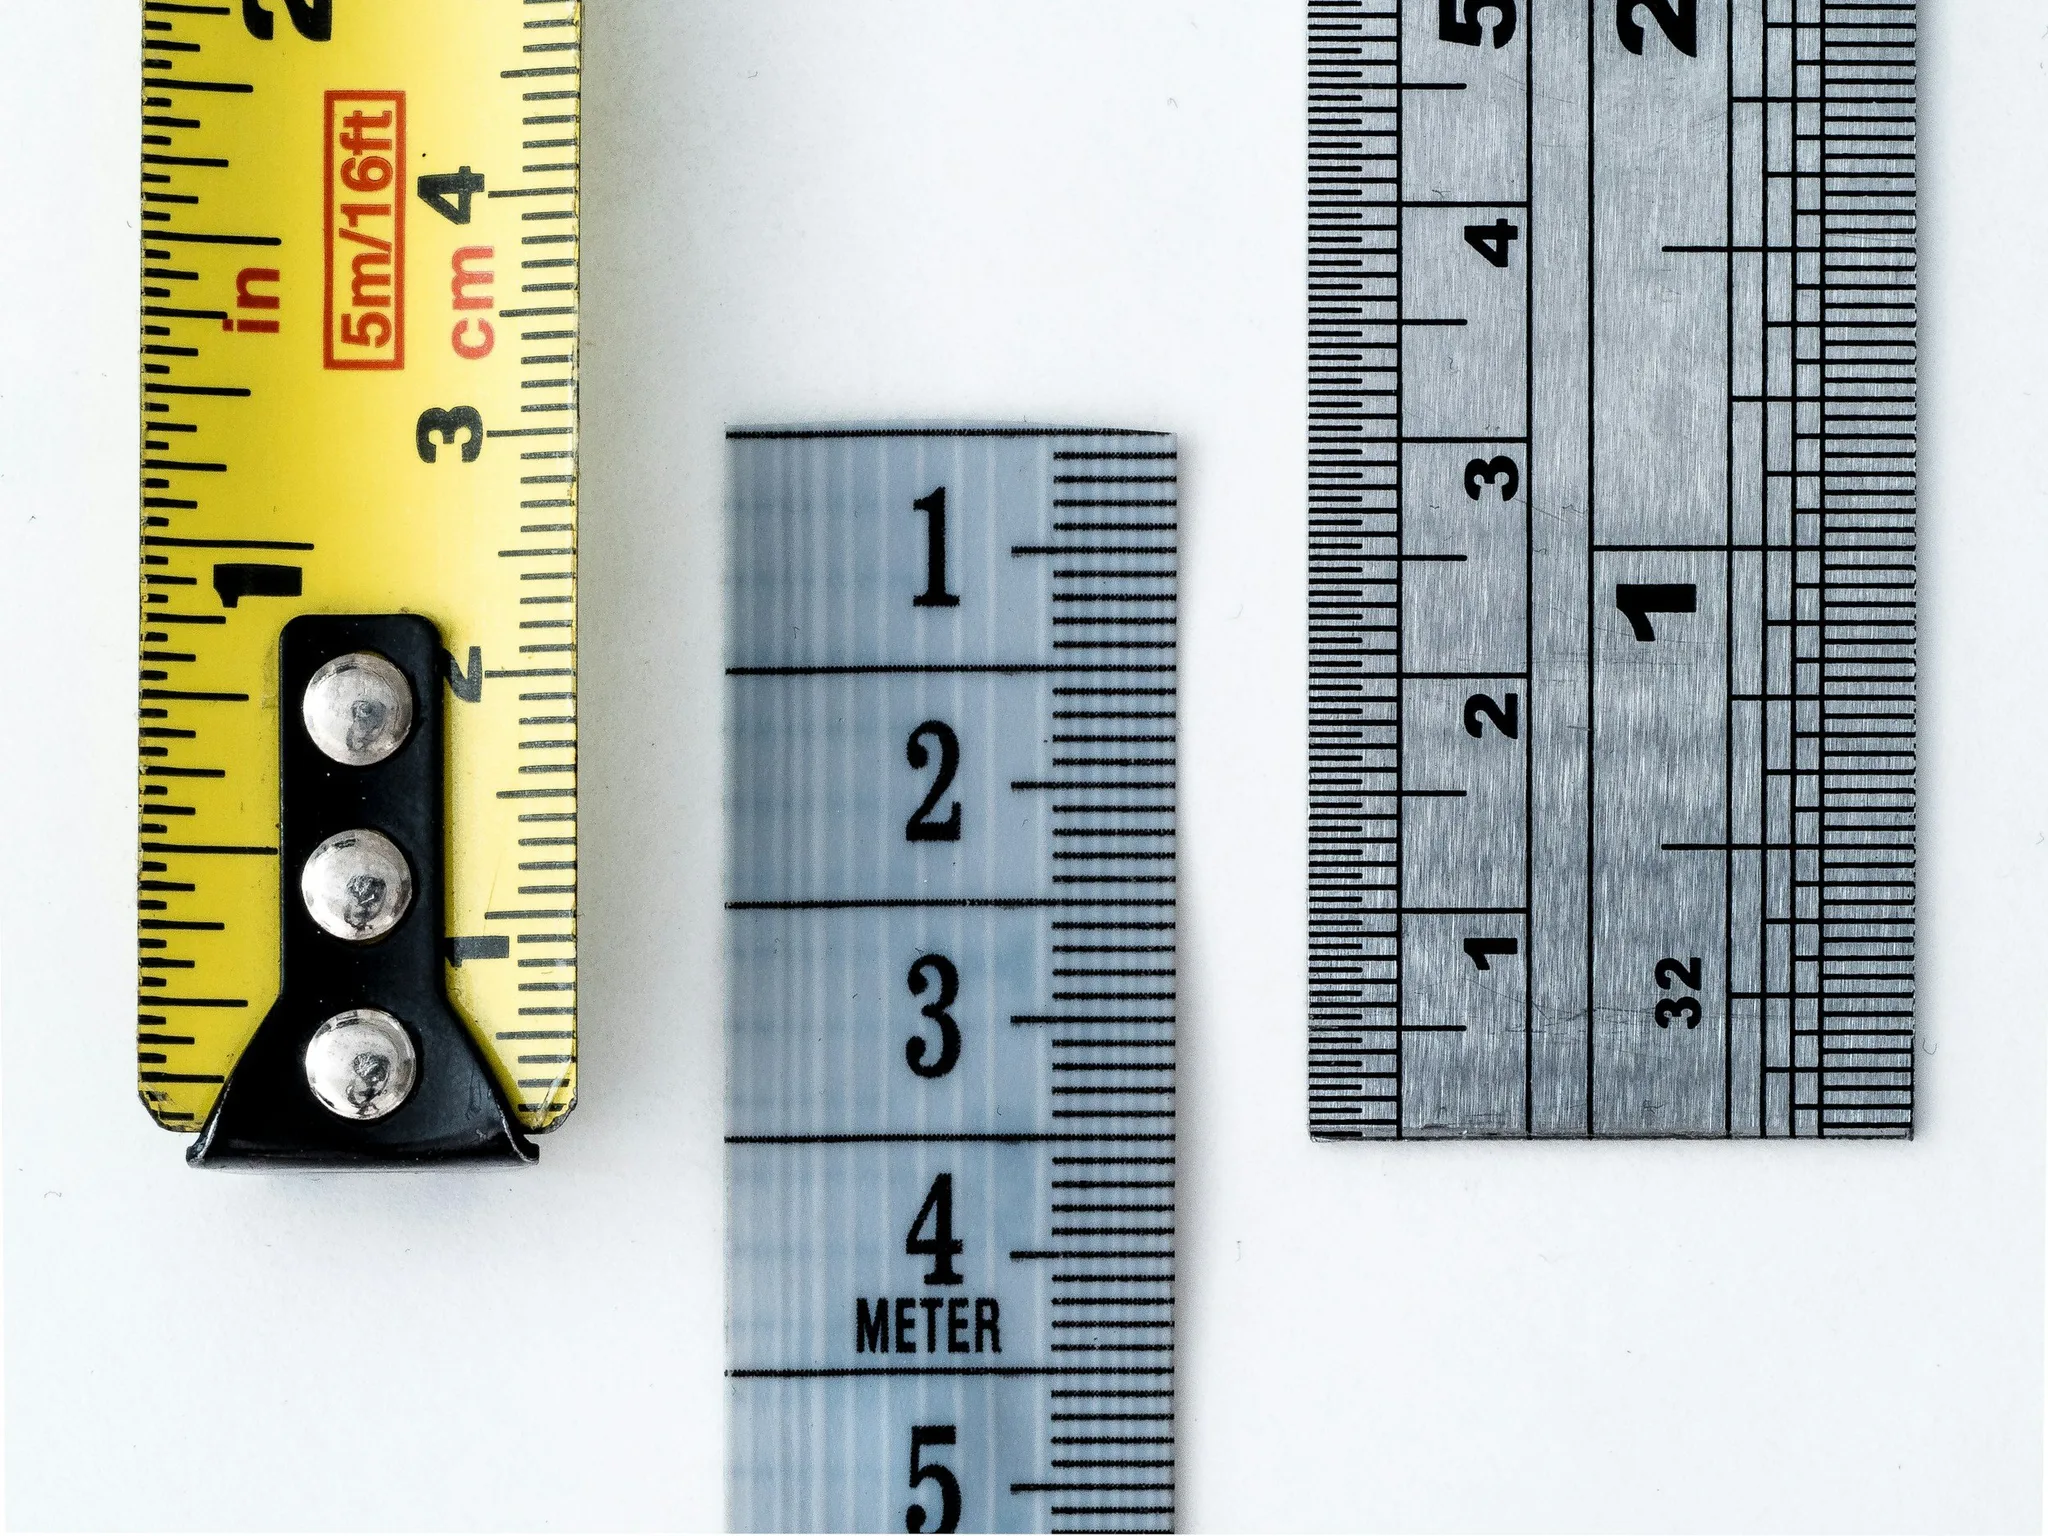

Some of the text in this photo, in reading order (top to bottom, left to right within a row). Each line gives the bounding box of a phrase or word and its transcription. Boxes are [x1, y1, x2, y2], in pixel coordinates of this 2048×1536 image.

[1439, 0, 1518, 49] 5
[1615, 0, 1698, 58] 2
[417, 165, 485, 225] 4
[339, 109, 393, 348] 5m/16ft
[1464, 218, 1519, 268] 4
[222, 266, 281, 334] in
[451, 246, 495, 360] cm
[415, 405, 484, 464] 3
[1464, 455, 1520, 502] 3
[913, 486, 961, 607] 1
[213, 563, 303, 609] 1
[1615, 583, 1698, 643] 1
[440, 645, 483, 704] 2
[1464, 692, 1519, 740] 2
[906, 719, 961, 842] 2
[445, 935, 510, 968] 1
[1464, 937, 1519, 971] 1
[905, 953, 961, 1079] 3
[1654, 956, 1703, 1030] 32
[905, 1172, 964, 1286] 4
[855, 1297, 1003, 1354] METER
[905, 1425, 962, 1535] 5
